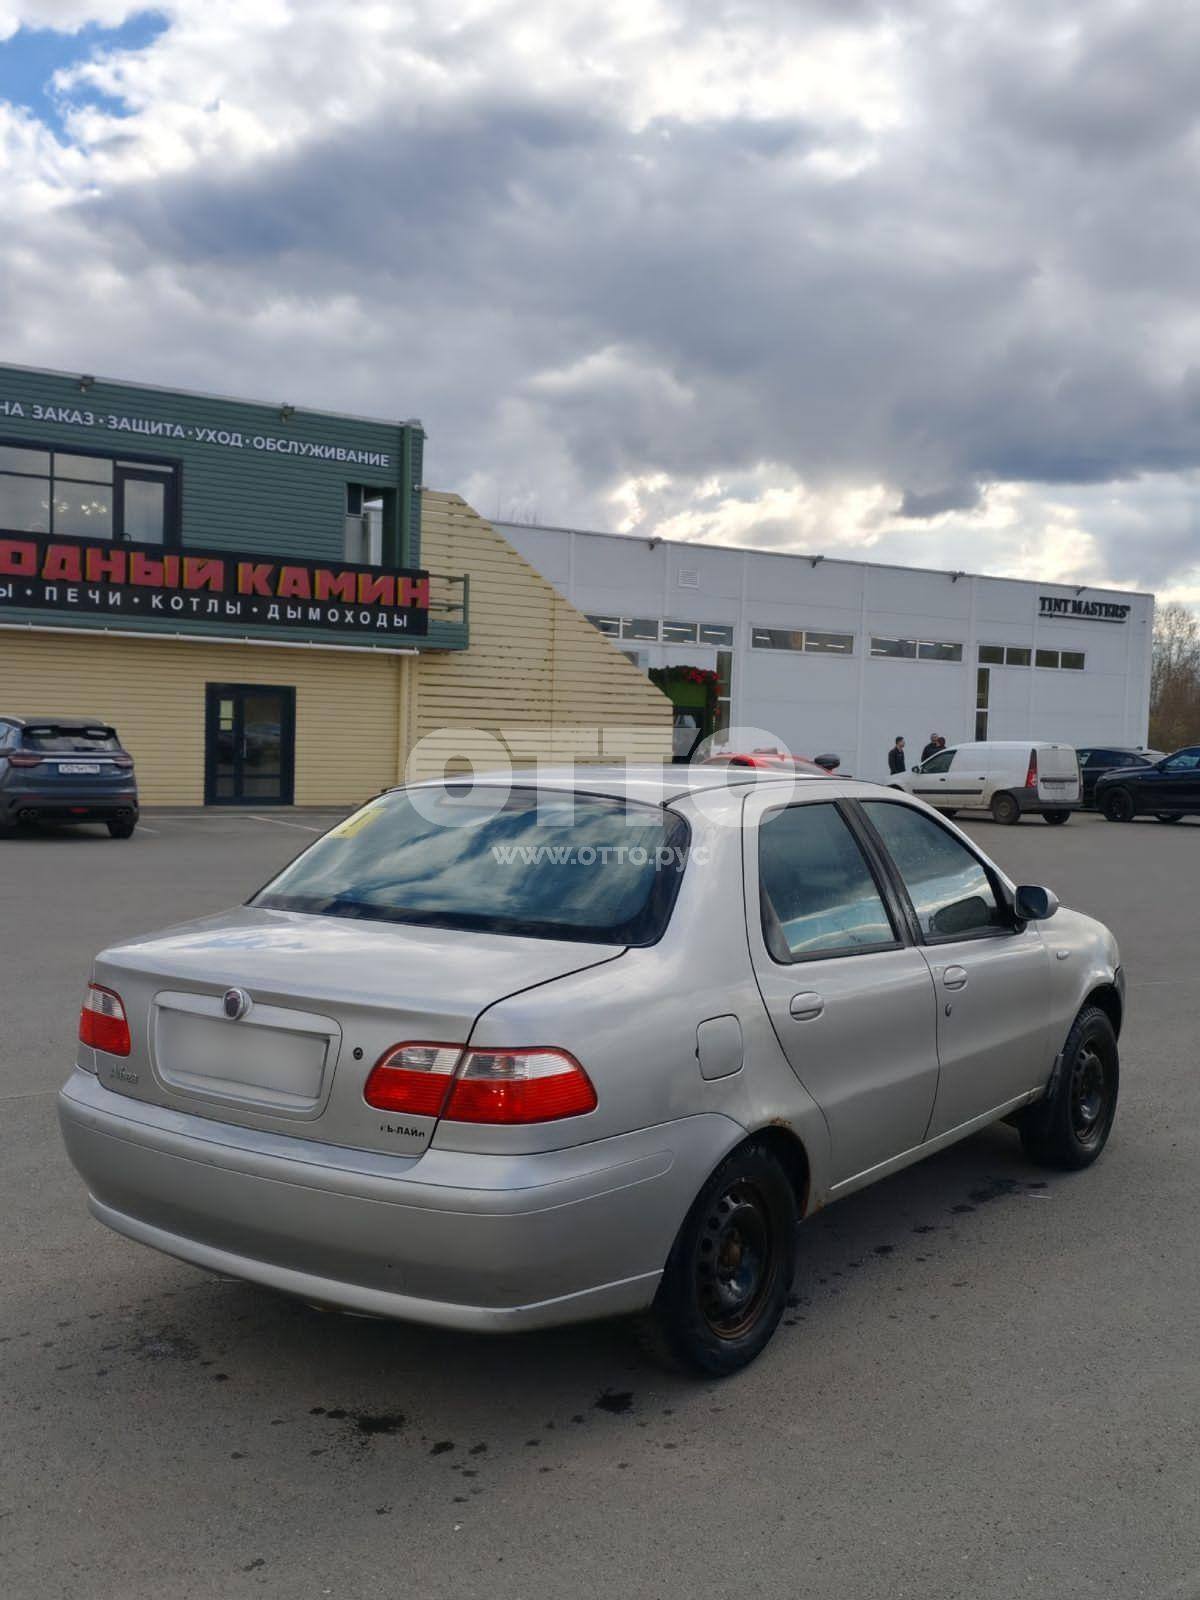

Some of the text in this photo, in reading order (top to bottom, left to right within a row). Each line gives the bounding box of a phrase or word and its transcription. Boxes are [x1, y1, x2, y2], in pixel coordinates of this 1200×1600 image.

[33, 405, 94, 426] ЗАКАЗ
[108, 416, 185, 438] ЗАЩИТА
[195, 427, 243, 448] УХОД
[253, 437, 390, 467] ОБСЛУЖИВАНИЕ
[45, 585, 122, 606] ПЕЧИ
[151, 594, 242, 615] КОТЛЫ
[267, 603, 409, 629] ДЫМОХОДЫ
[238, 562, 430, 609] КАМИН
[1039, 597, 1128, 619] TINT MASTERS
